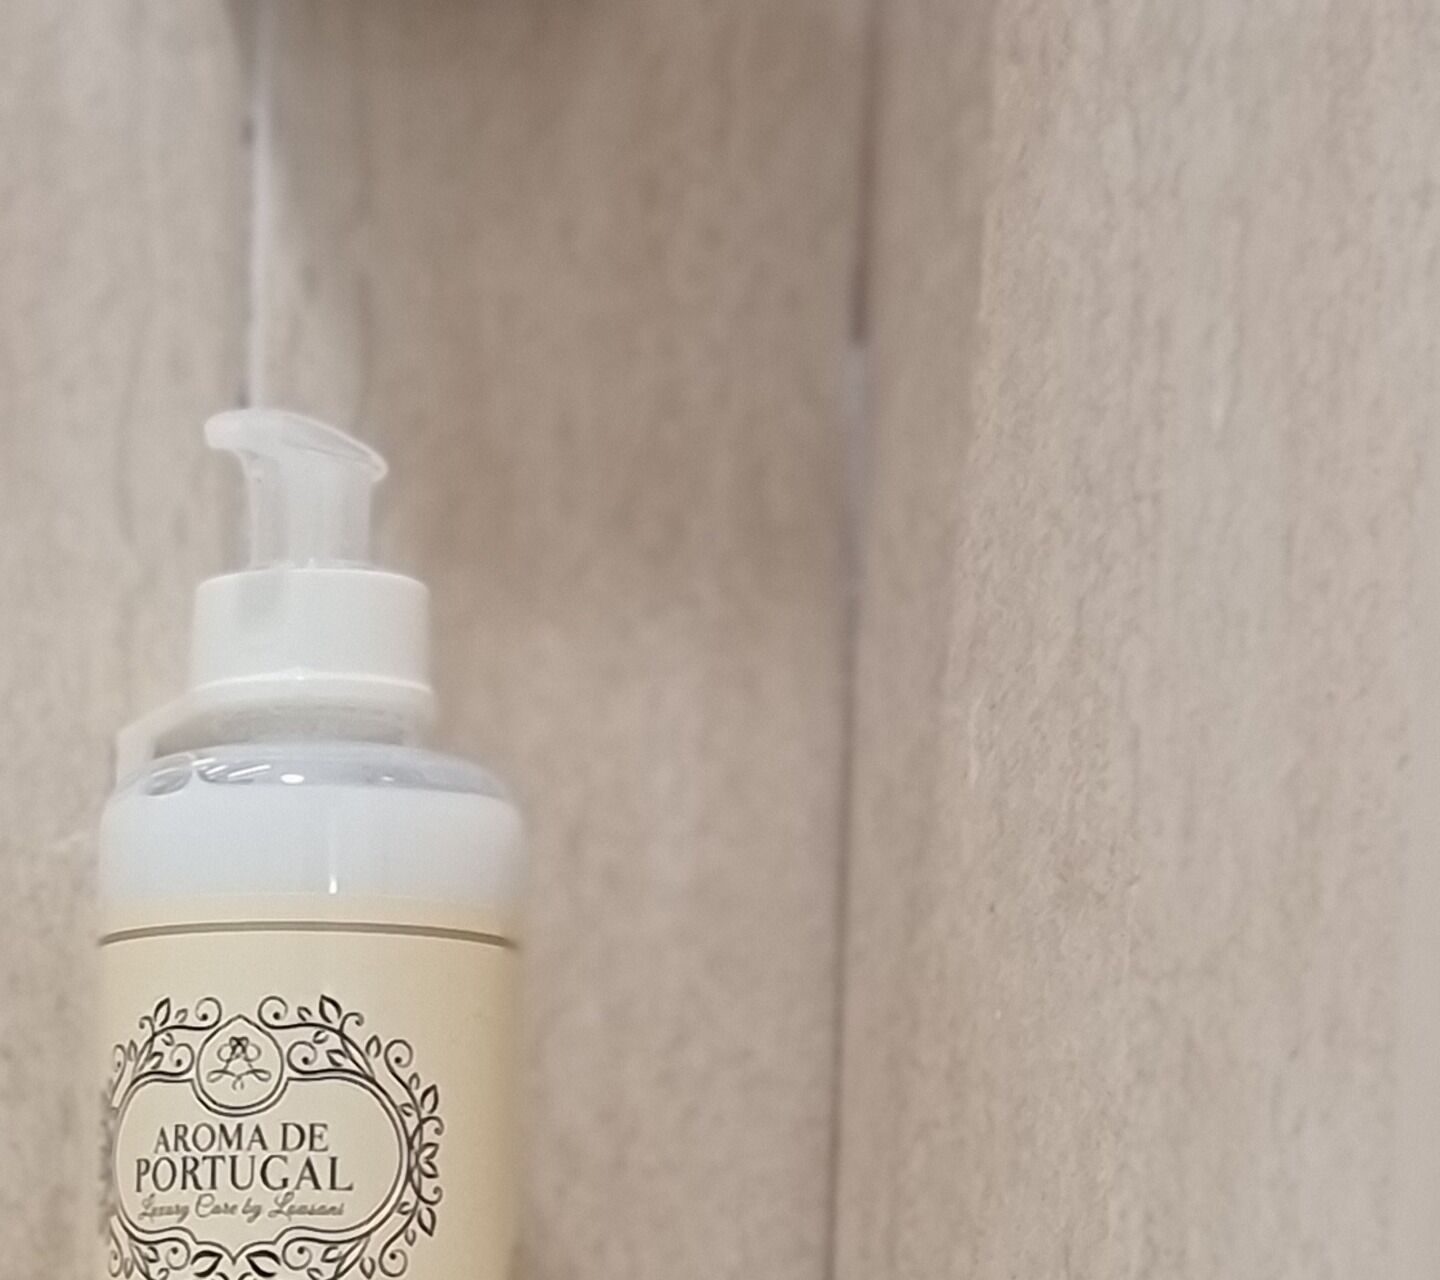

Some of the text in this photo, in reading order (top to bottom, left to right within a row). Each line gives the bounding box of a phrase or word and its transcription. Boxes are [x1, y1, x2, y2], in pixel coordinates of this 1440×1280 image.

[154, 1122, 329, 1154] AROMA DE
[135, 1155, 354, 1193] PORTUGAL
[241, 1197, 263, 1224] by
